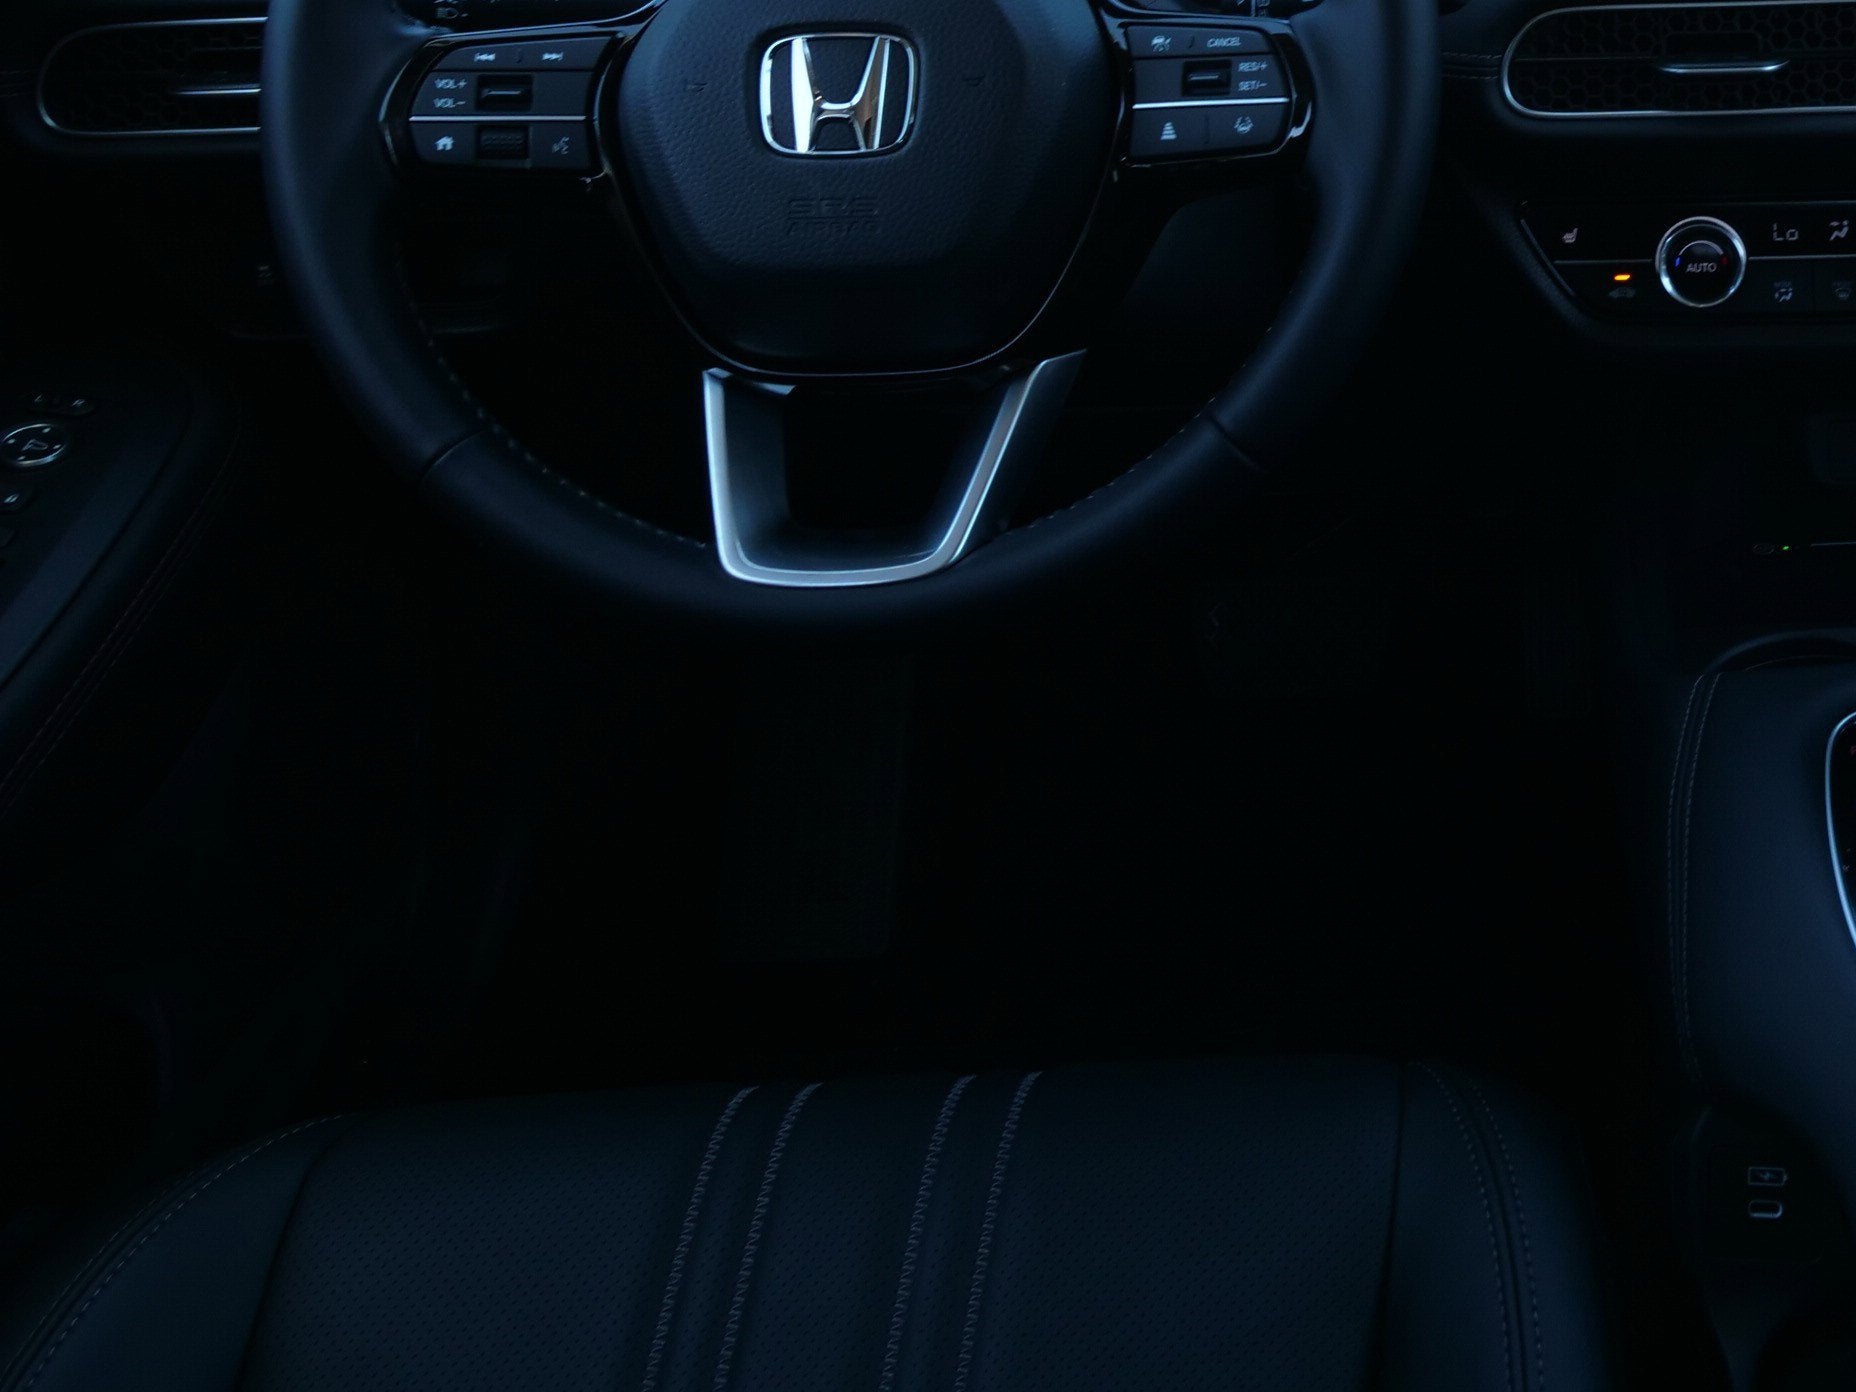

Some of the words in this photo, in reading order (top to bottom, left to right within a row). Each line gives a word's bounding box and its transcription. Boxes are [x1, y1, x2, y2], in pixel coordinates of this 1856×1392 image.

[1206, 36, 1242, 48] CANCEL
[1772, 222, 1800, 241] Lo
[1686, 262, 1718, 273] AUTO
